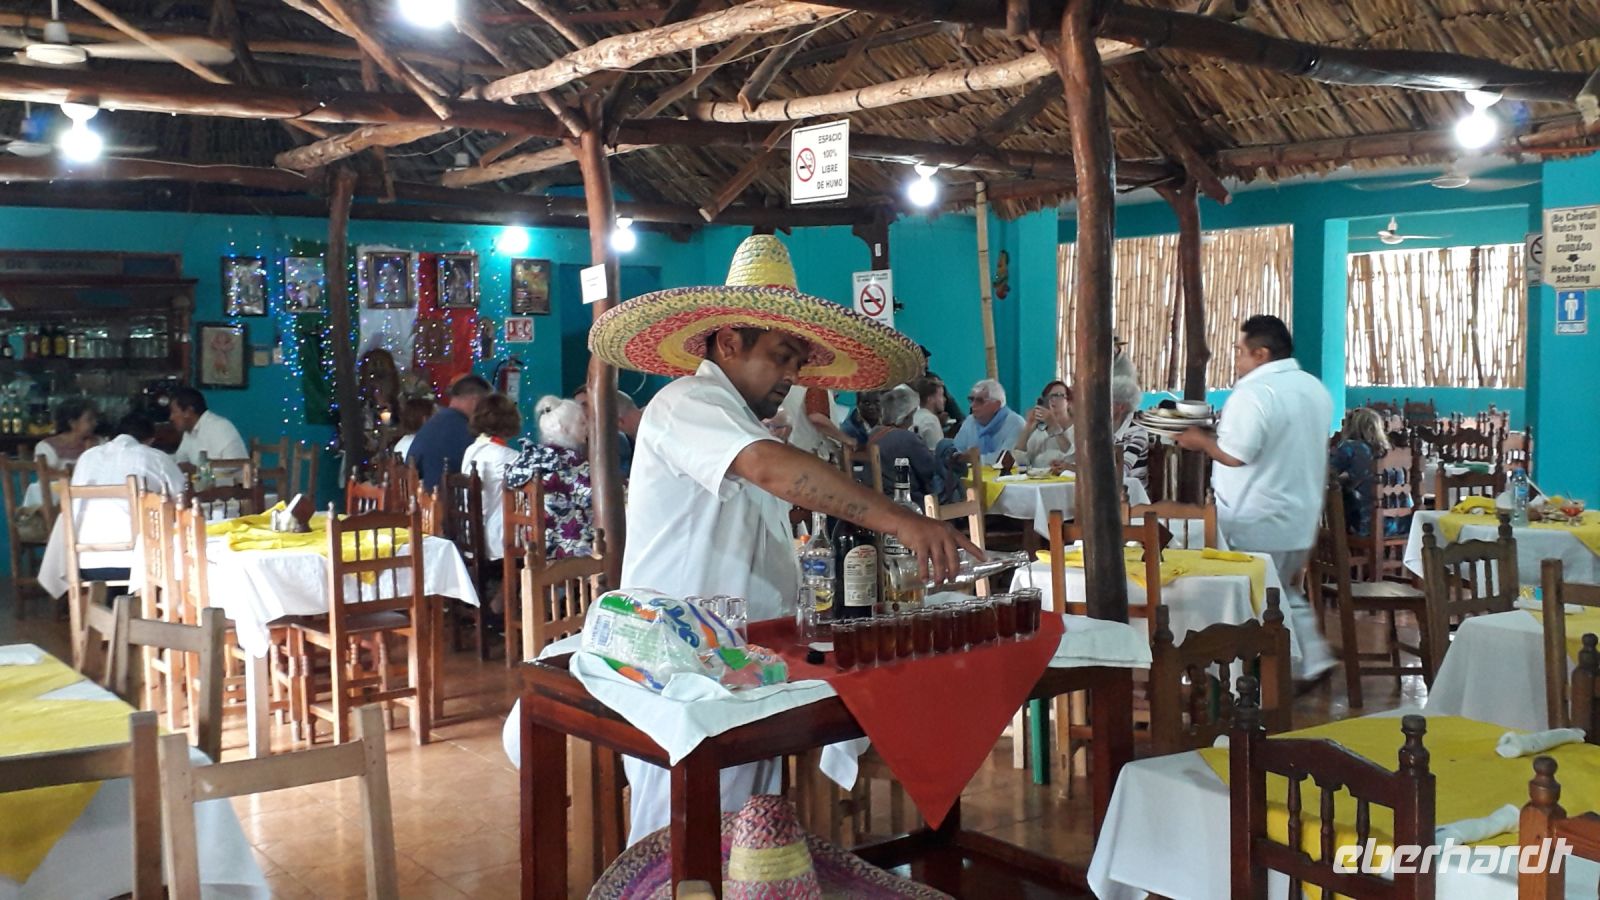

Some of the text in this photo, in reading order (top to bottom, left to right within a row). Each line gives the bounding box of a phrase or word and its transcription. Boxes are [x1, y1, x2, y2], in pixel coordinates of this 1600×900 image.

[818, 132, 842, 144] ESPACIO
[823, 149, 838, 158] 100%
[822, 163, 838, 174] LIBRE
[817, 178, 843, 190] DE HUMO
[1552, 222, 1596, 232] Watch Your
[1565, 233, 1584, 242] Step
[1551, 263, 1596, 273] Hohe Stufe
[1556, 275, 1590, 284] Achtung
